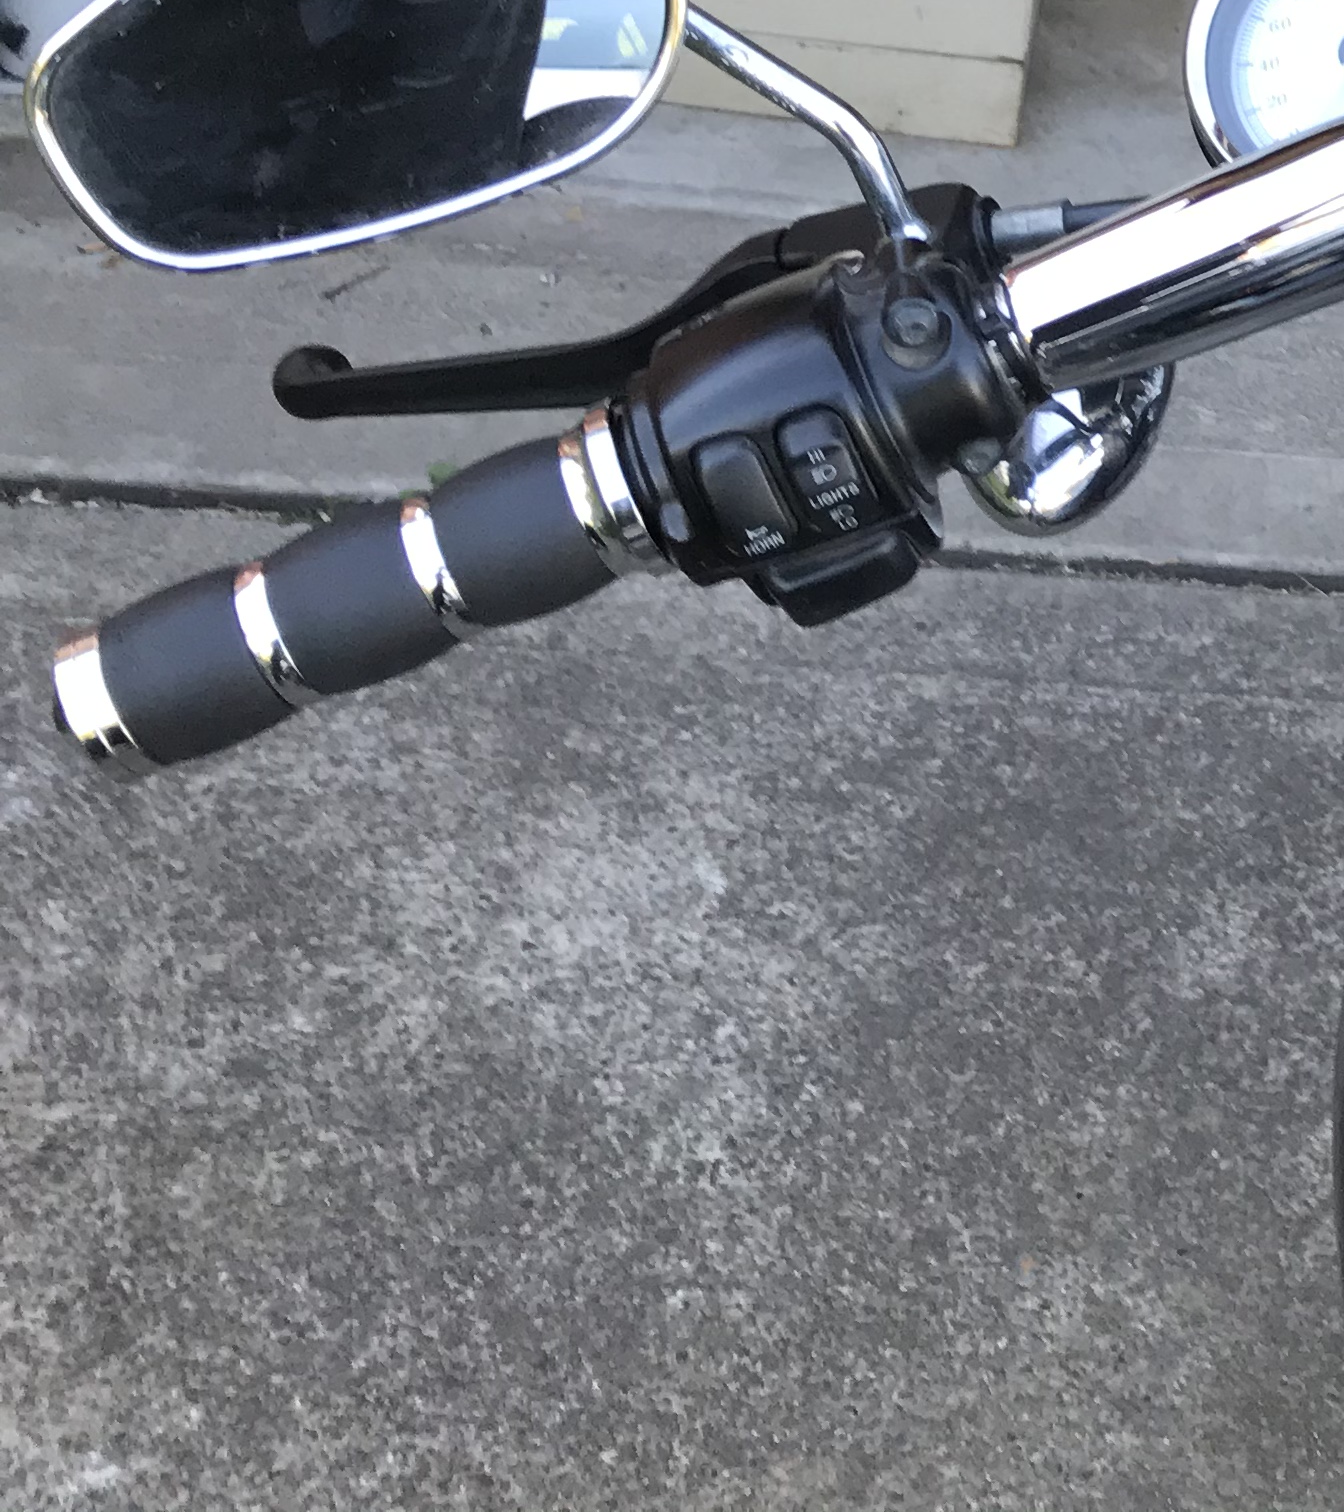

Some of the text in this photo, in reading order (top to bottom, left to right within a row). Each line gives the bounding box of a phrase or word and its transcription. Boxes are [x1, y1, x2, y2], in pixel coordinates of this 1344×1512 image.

[1269, 17, 1292, 33] 60
[1260, 56, 1280, 72] 40
[1266, 93, 1288, 109] 20
[808, 481, 860, 510] LIGHTS
[743, 530, 786, 558] HORN
